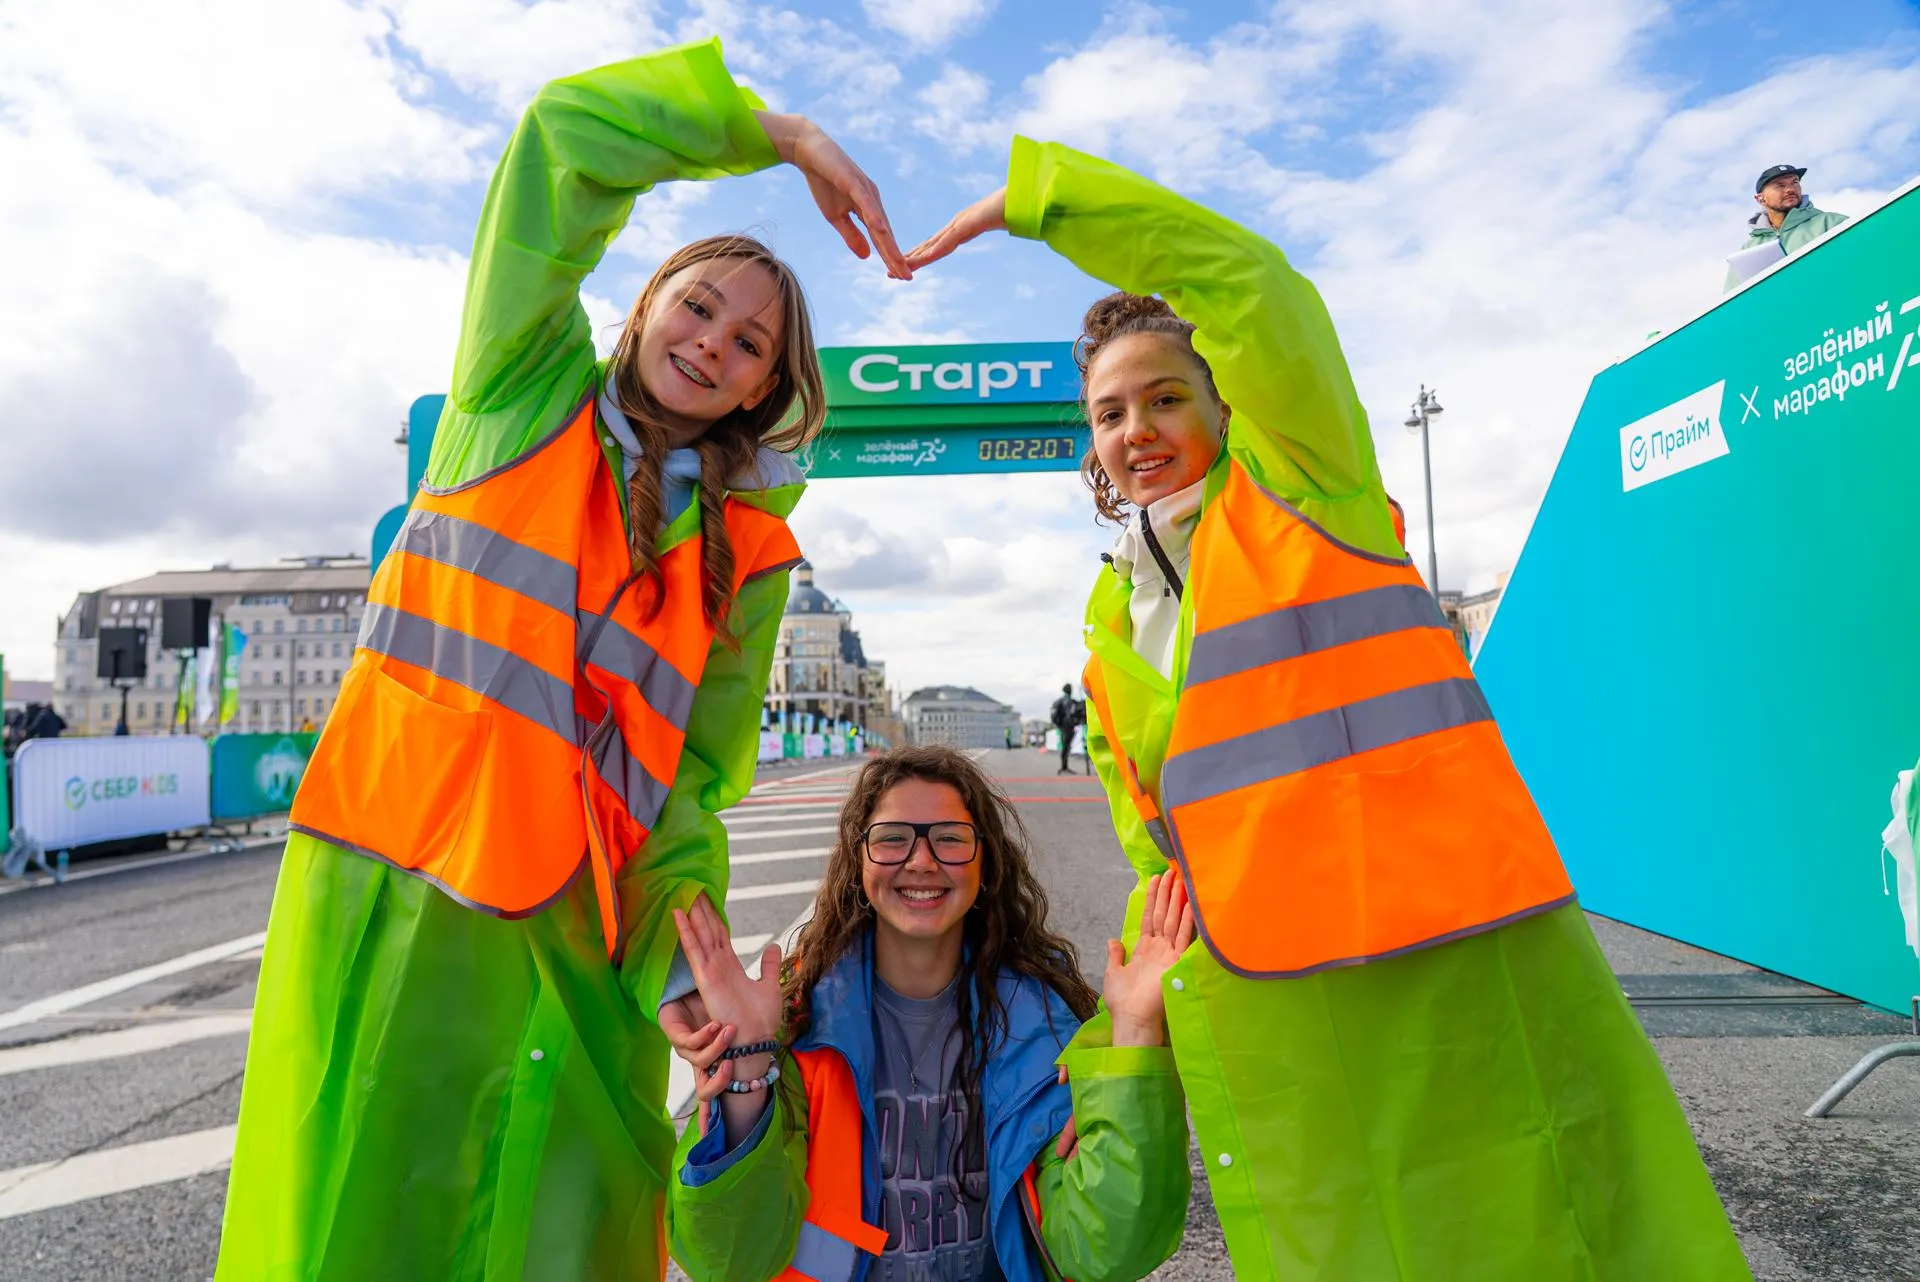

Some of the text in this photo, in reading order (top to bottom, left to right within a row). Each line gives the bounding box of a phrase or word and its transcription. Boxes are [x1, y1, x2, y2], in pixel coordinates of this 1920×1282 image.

[1783, 300, 1893, 382] зелёный
[849, 354, 1053, 398] Старт
[1773, 352, 1885, 420] марафон
[856, 450, 914, 465] марафон
[864, 439, 919, 452] зелёный
[1651, 414, 1711, 459] Прайм
[881, 1172, 989, 1254] ORRY
